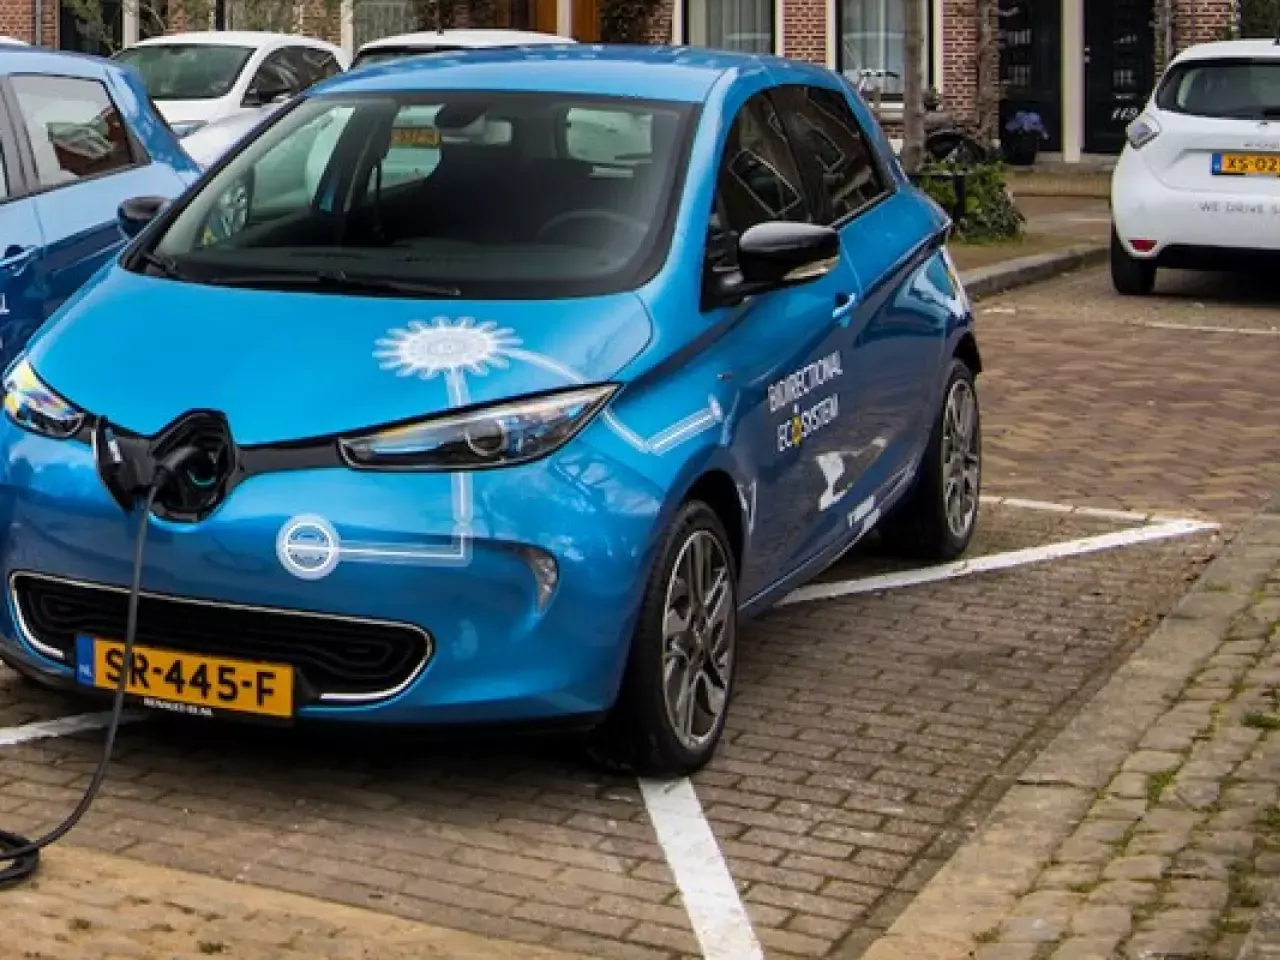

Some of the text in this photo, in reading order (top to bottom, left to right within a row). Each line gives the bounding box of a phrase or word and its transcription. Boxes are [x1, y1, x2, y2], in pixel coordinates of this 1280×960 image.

[1228, 157, 1280, 172] XS-02
[768, 350, 843, 413] BIDIRECTIONAL
[777, 392, 839, 452] ECOSYSTEM
[104, 647, 277, 707] SR-445-F
